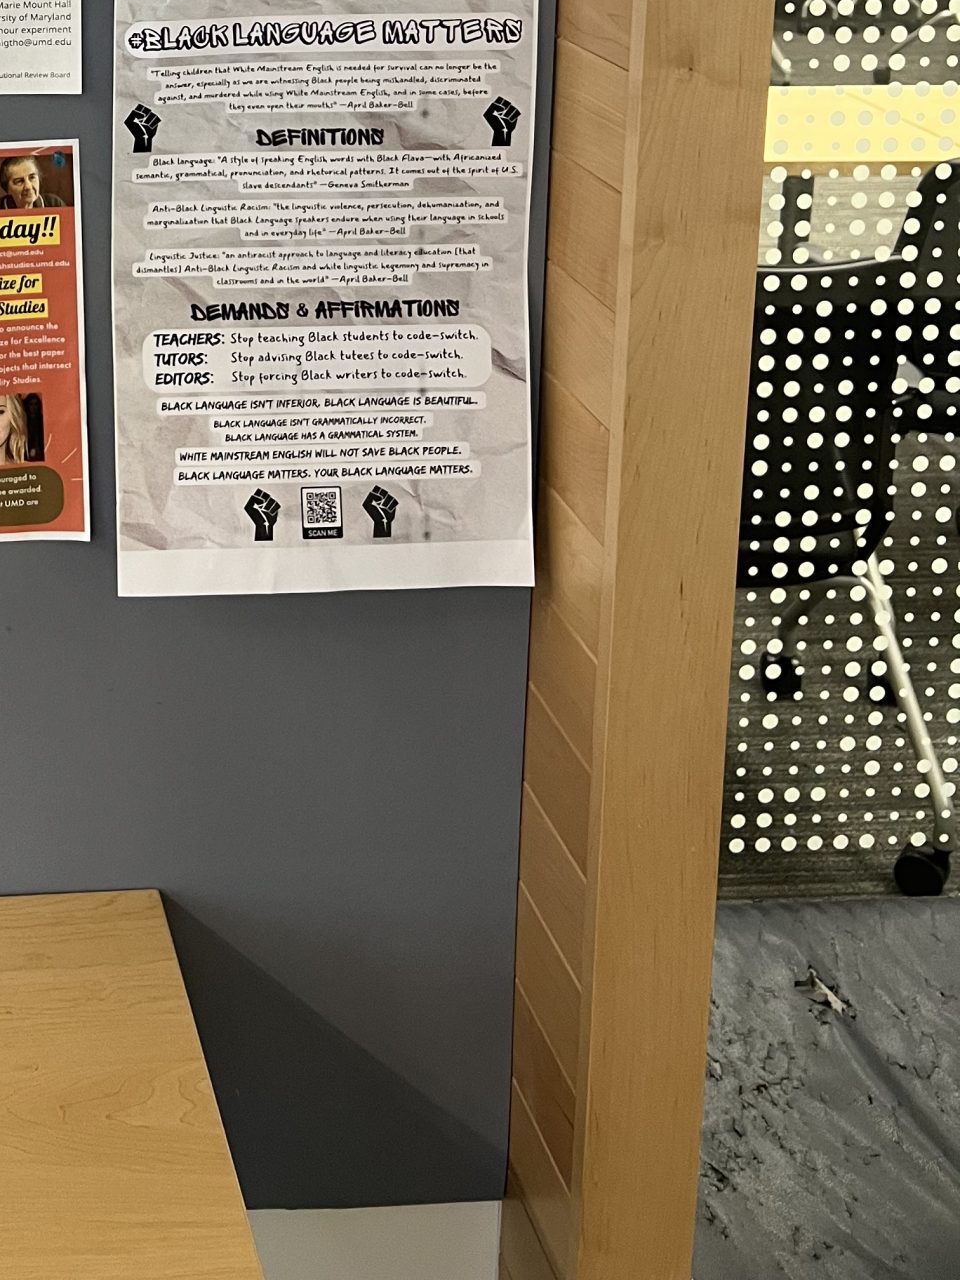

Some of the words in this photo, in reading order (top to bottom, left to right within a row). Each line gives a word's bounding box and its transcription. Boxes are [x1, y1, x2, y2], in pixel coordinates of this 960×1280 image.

[22, 0, 52, 9] Mount
[54, 0, 71, 8] Hall
[127, 23, 229, 52] #BLACK
[231, 19, 377, 47] LANGUAGE
[381, 17, 522, 45] MATTERS
[255, 127, 384, 147] DEFINITIONS
[15, 275, 40, 293] for
[190, 301, 289, 321] DEMANDS
[295, 302, 309, 317] &
[314, 298, 459, 319] AFFIRMATIONS
[152, 331, 225, 347] TEACHERS:
[230, 332, 253, 347] Stop
[257, 331, 304, 347] teaching
[308, 330, 338, 343] Black
[342, 329, 389, 341] students
[392, 329, 403, 341] to
